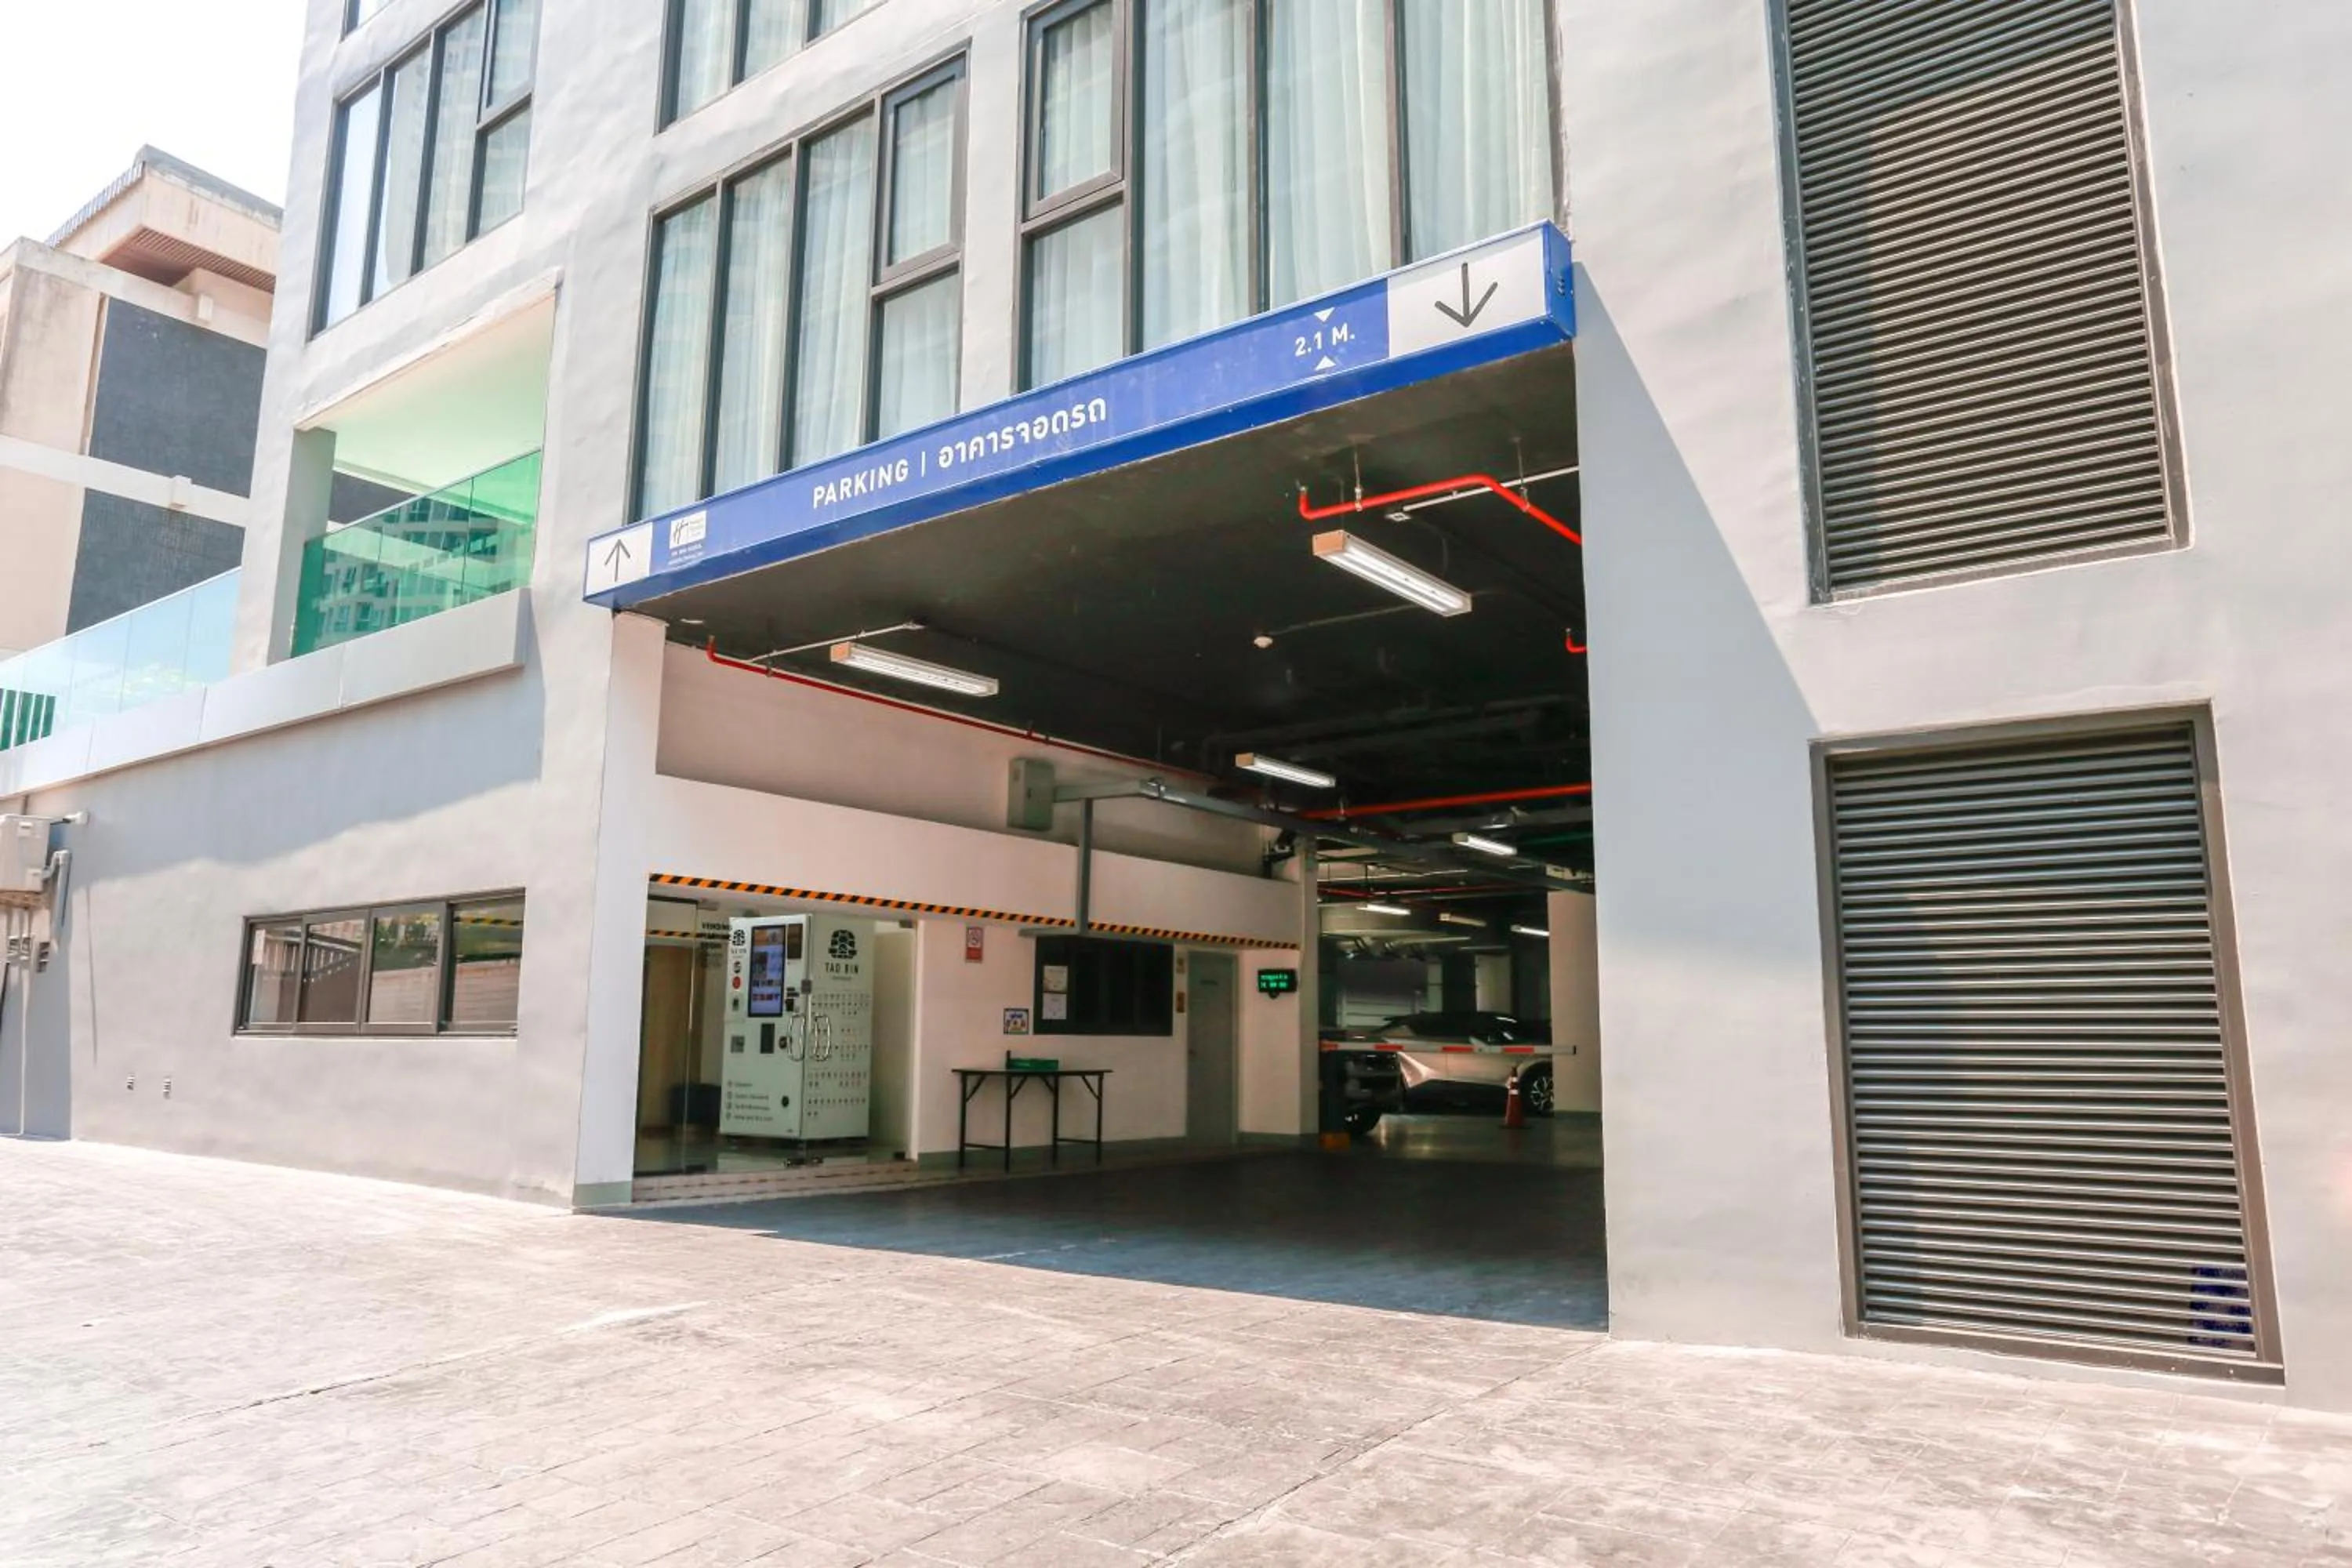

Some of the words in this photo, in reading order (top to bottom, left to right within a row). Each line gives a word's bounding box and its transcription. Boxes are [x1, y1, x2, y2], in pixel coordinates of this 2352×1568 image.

[1294, 331, 1322, 358] 2.1
[1332, 322, 1356, 346] M.
[938, 397, 1107, 469] อาคารจอดรถ
[812, 458, 909, 510] PARKING
